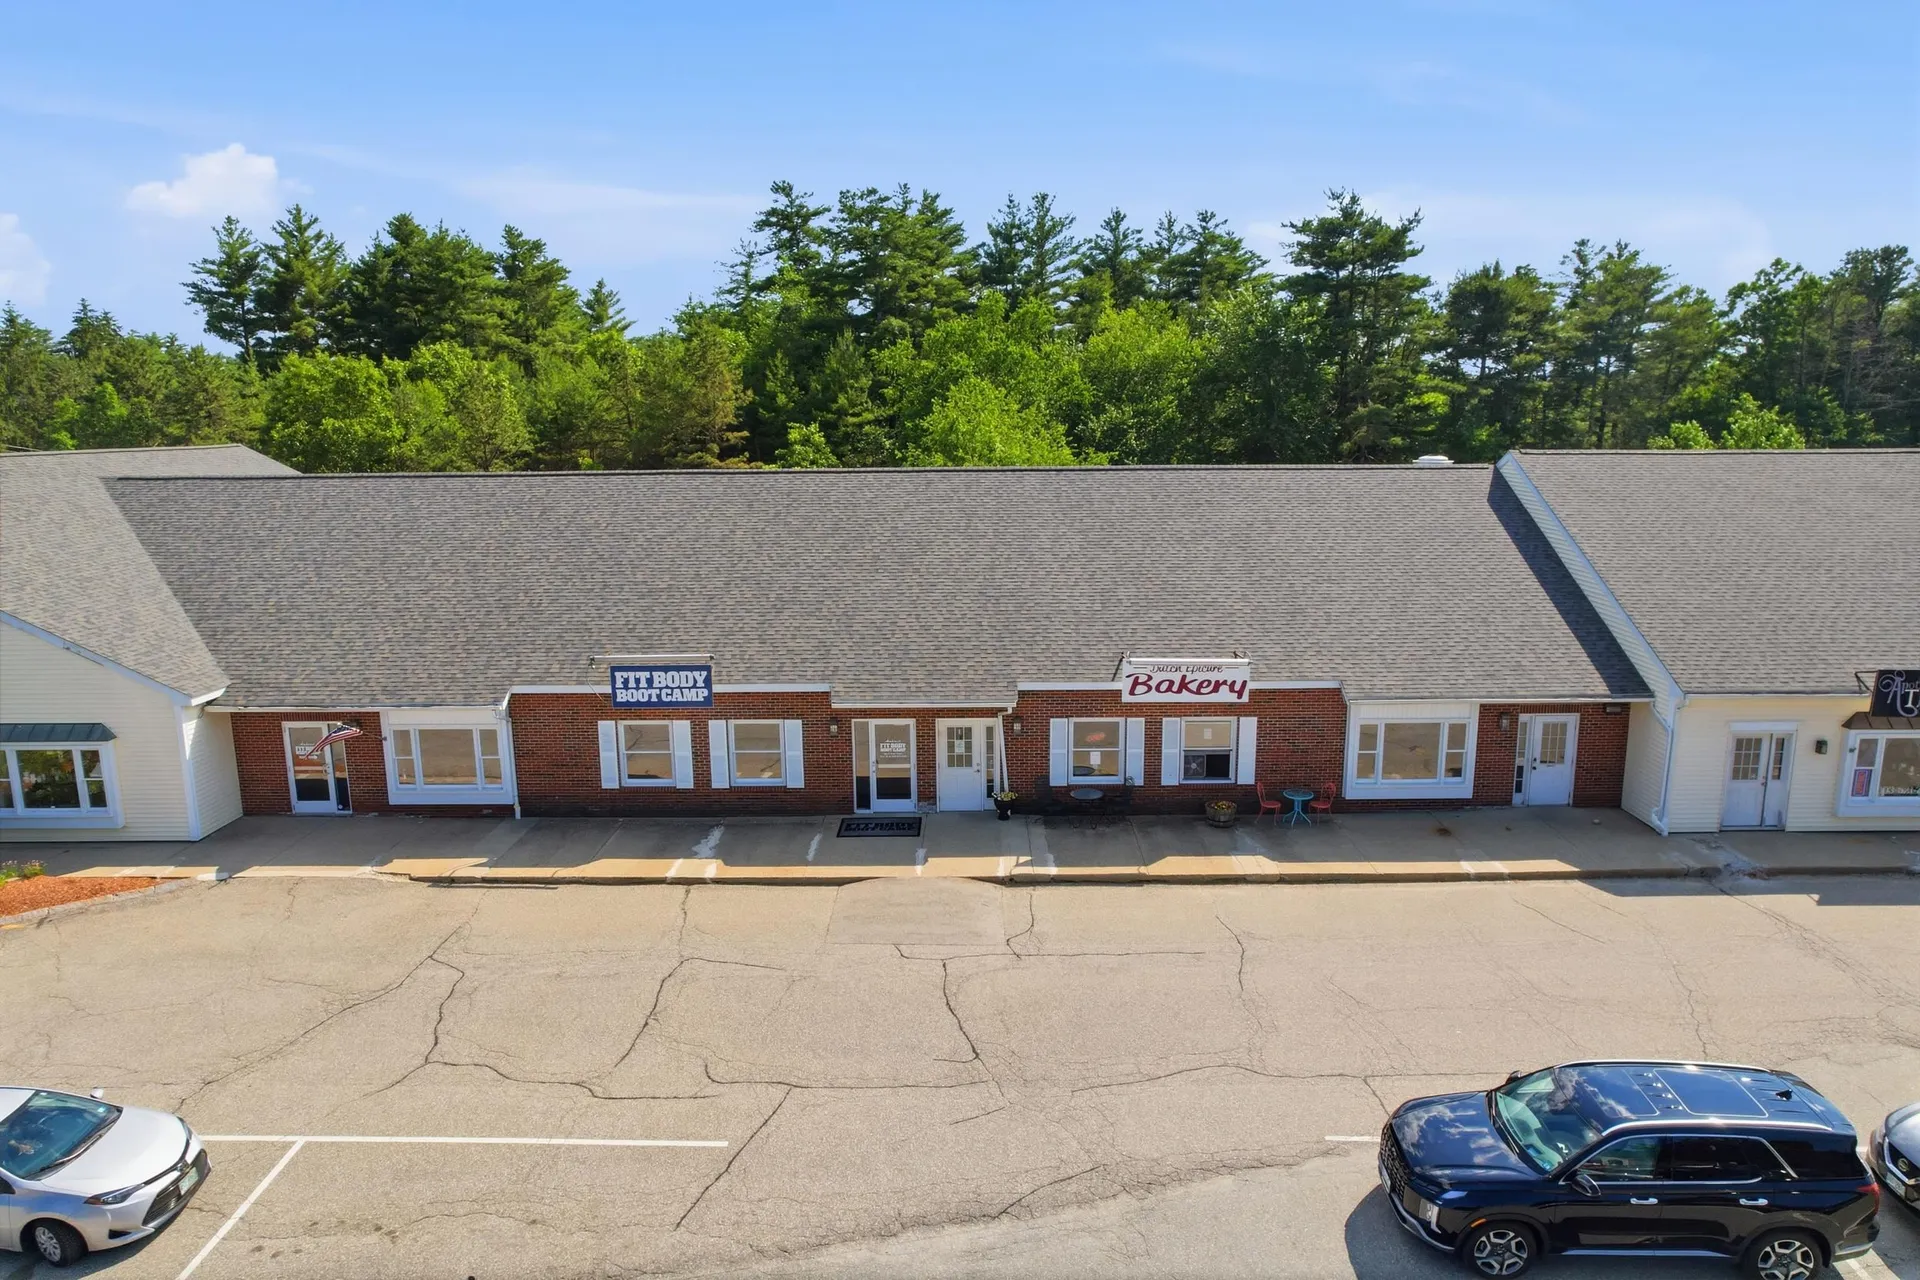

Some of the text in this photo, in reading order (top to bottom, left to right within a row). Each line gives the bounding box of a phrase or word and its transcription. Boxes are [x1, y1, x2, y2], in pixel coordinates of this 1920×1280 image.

[614, 671, 707, 688] FIT BODY
[1125, 673, 1248, 700] Bakery
[616, 688, 709, 702] BOOT CAMP
